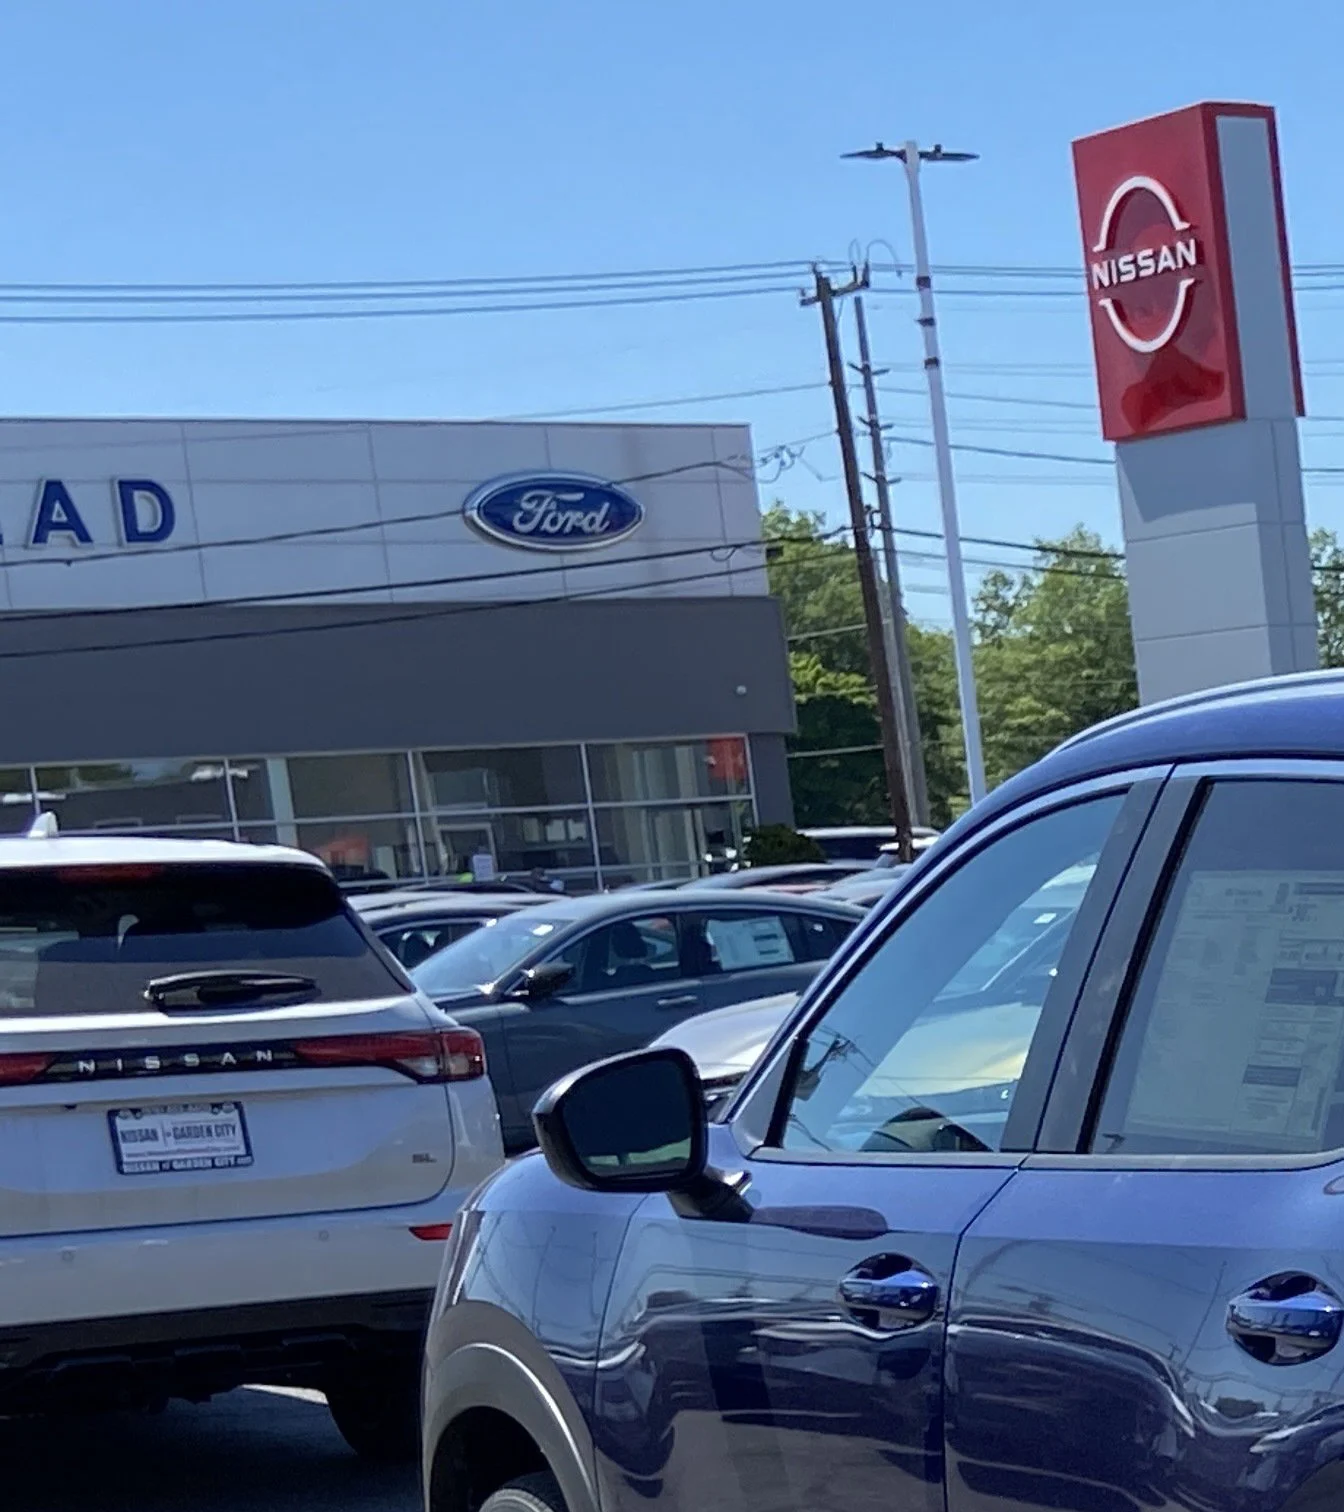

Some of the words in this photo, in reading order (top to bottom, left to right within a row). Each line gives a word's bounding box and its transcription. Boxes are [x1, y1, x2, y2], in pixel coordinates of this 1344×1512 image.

[1091, 237, 1197, 291] NISSAN
[0, 479, 176, 545] AD
[512, 489, 611, 534] Ford
[77, 1049, 273, 1075] NISSAN
